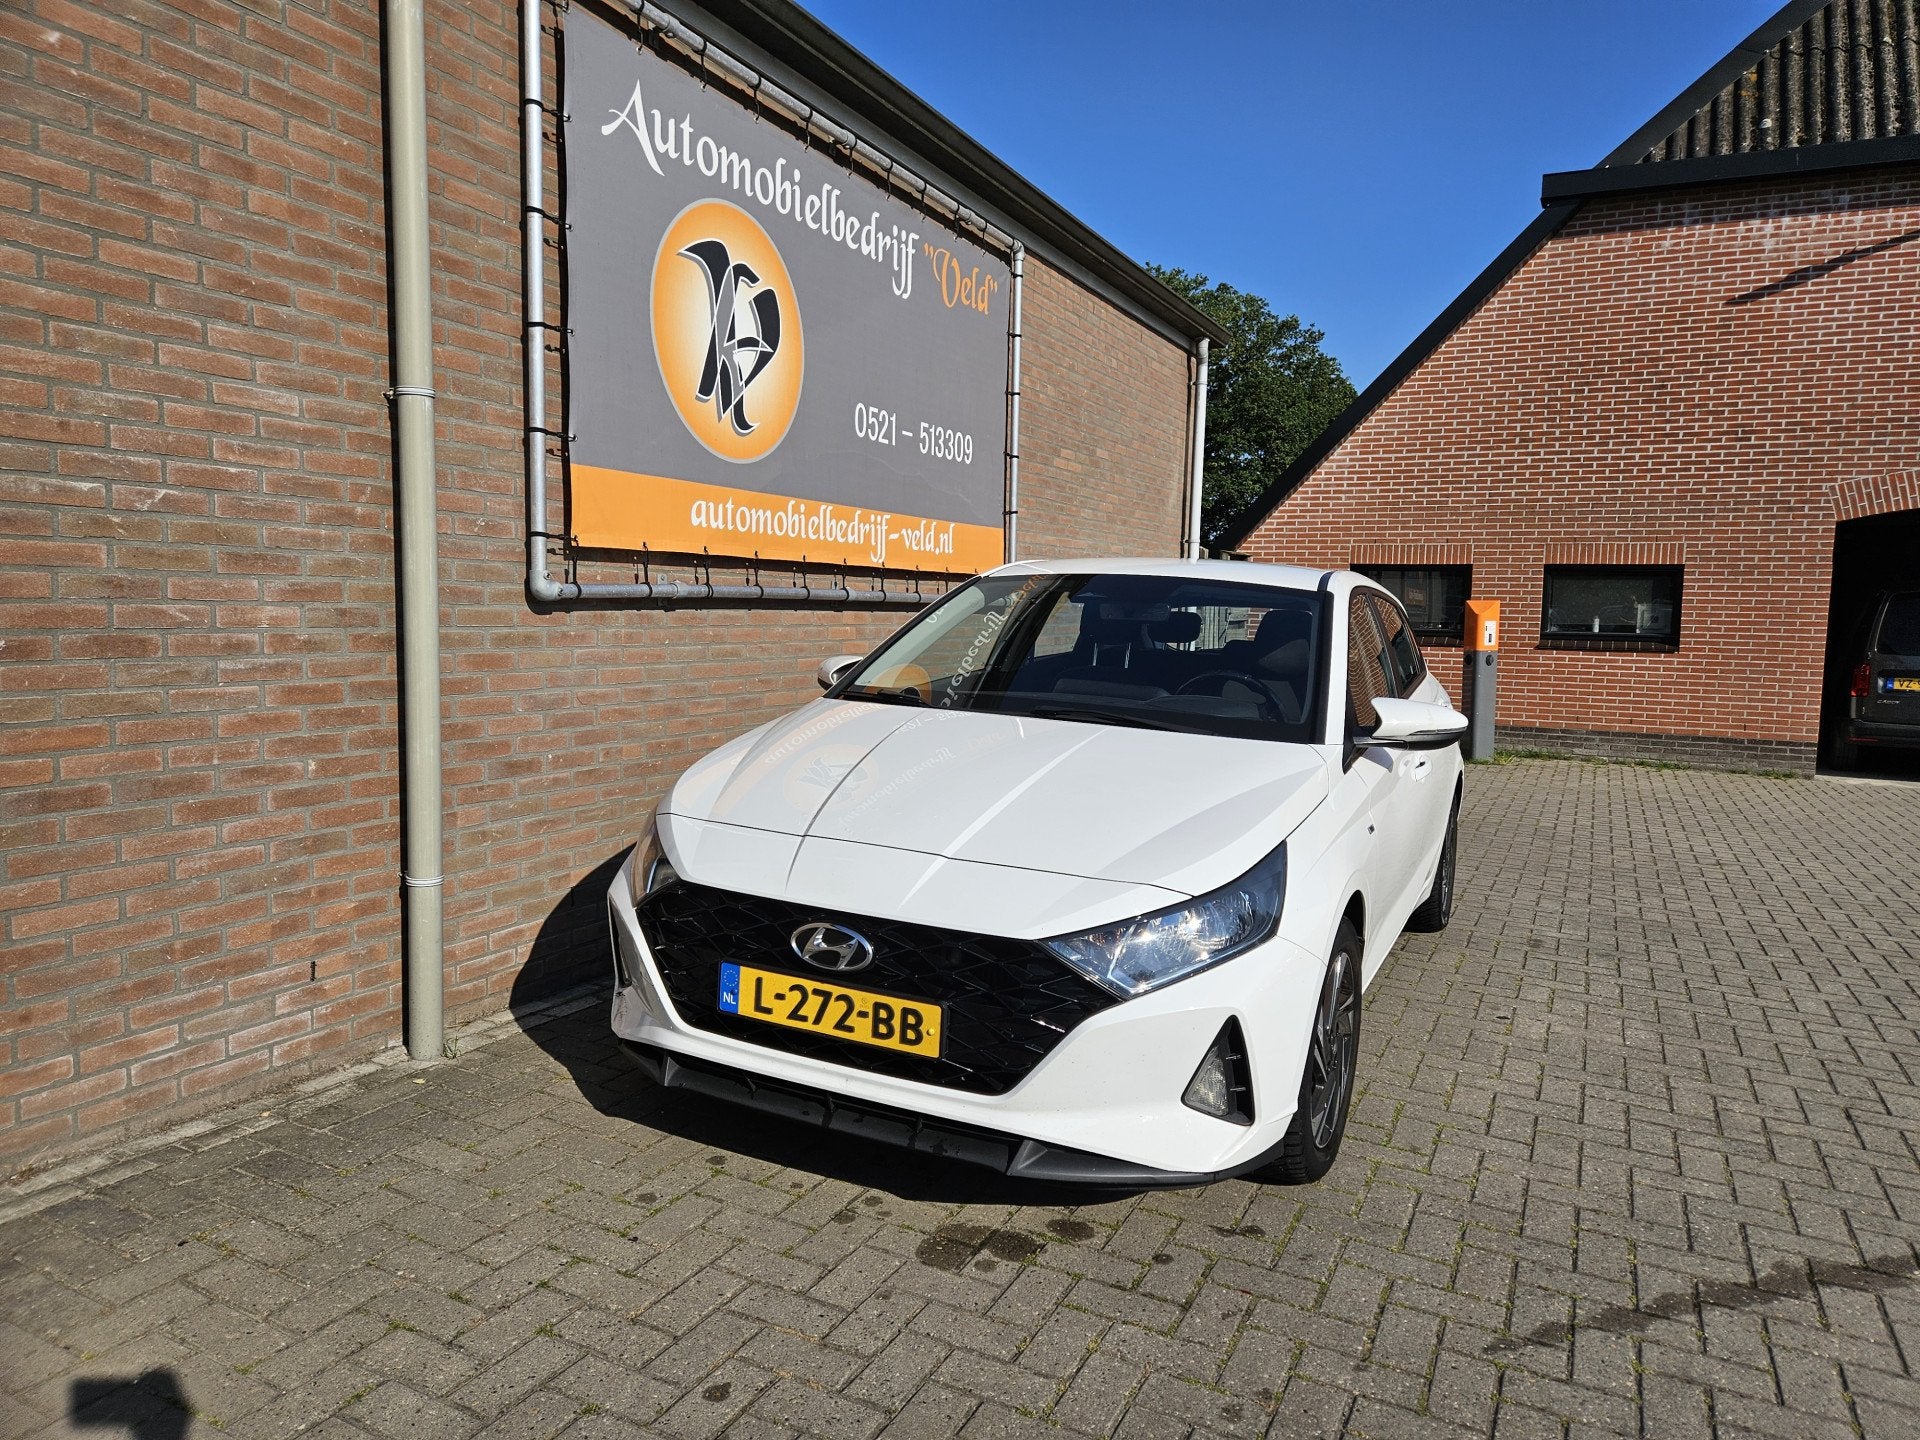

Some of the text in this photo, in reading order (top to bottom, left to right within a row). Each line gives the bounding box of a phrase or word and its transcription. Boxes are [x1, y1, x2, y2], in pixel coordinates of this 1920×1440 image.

[601, 79, 919, 299] Automobielbedrijf
[854, 402, 897, 446] 0521
[919, 422, 973, 465] 513309
[690, 497, 955, 563] automobielbedrijf-veld.nl
[723, 991, 737, 1005] NL
[753, 976, 924, 1046] L-272-BB
